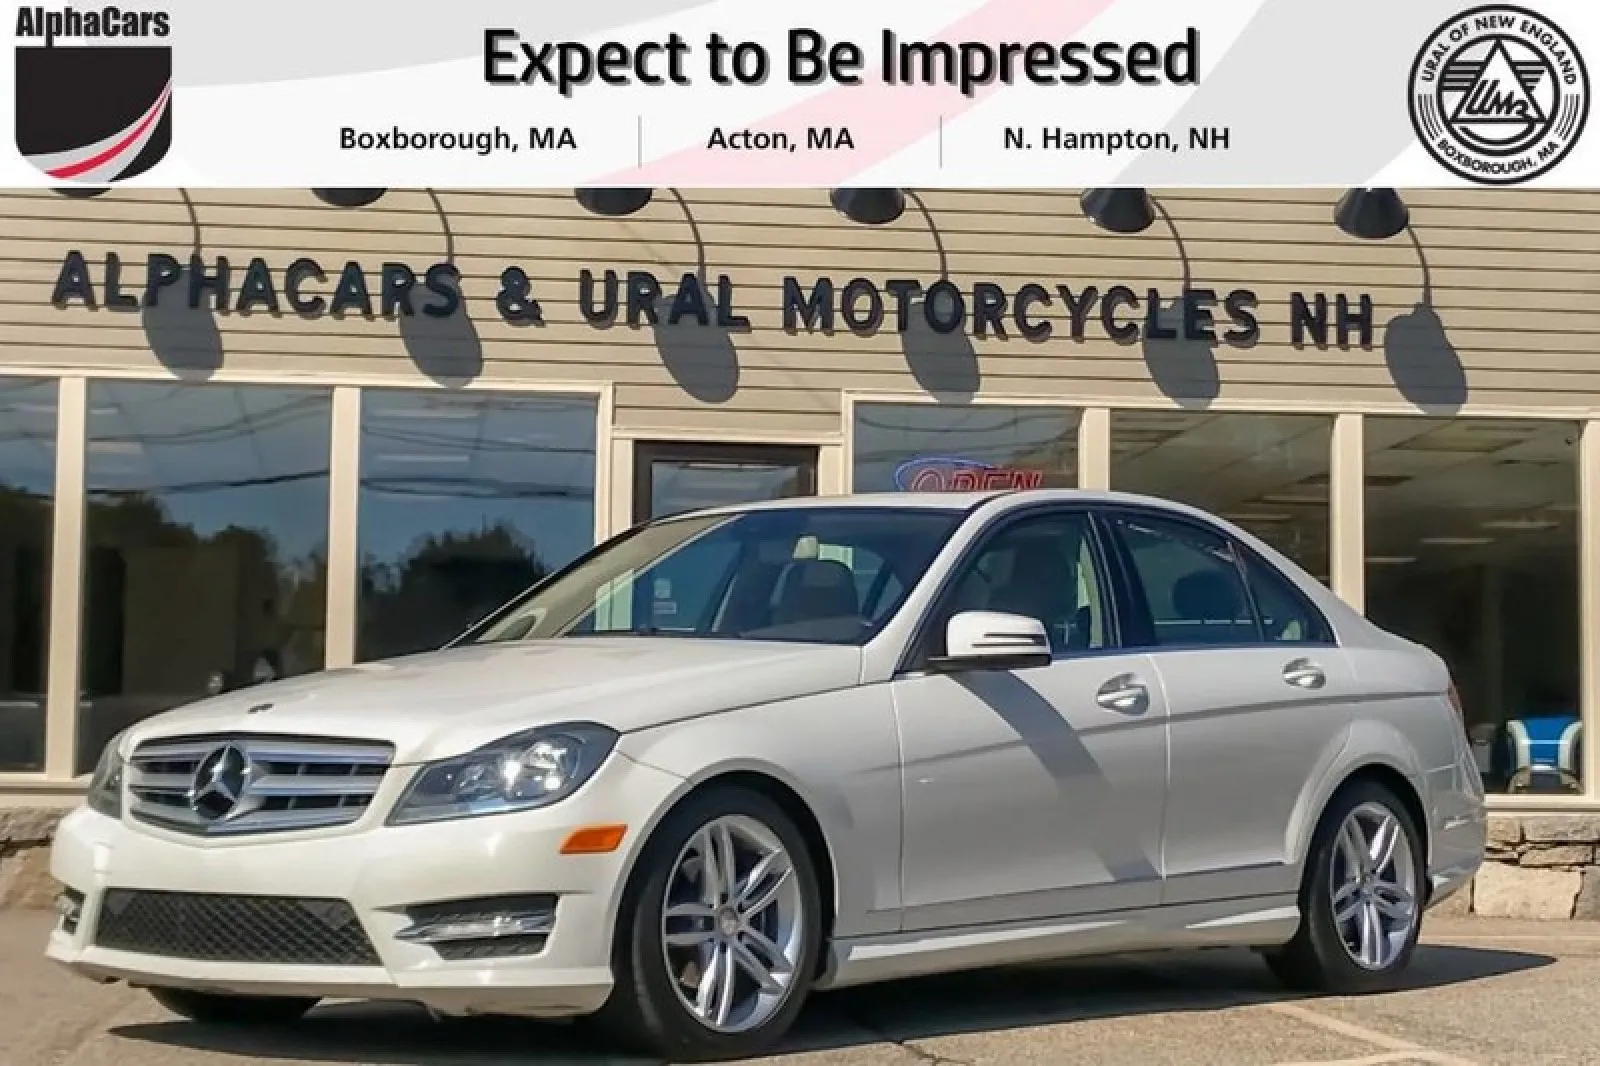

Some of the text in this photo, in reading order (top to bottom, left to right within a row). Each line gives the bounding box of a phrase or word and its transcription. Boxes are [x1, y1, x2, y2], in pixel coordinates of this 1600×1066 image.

[52, 250, 1374, 349] ALPHACARS & URAL MOTORCYCLES NH
